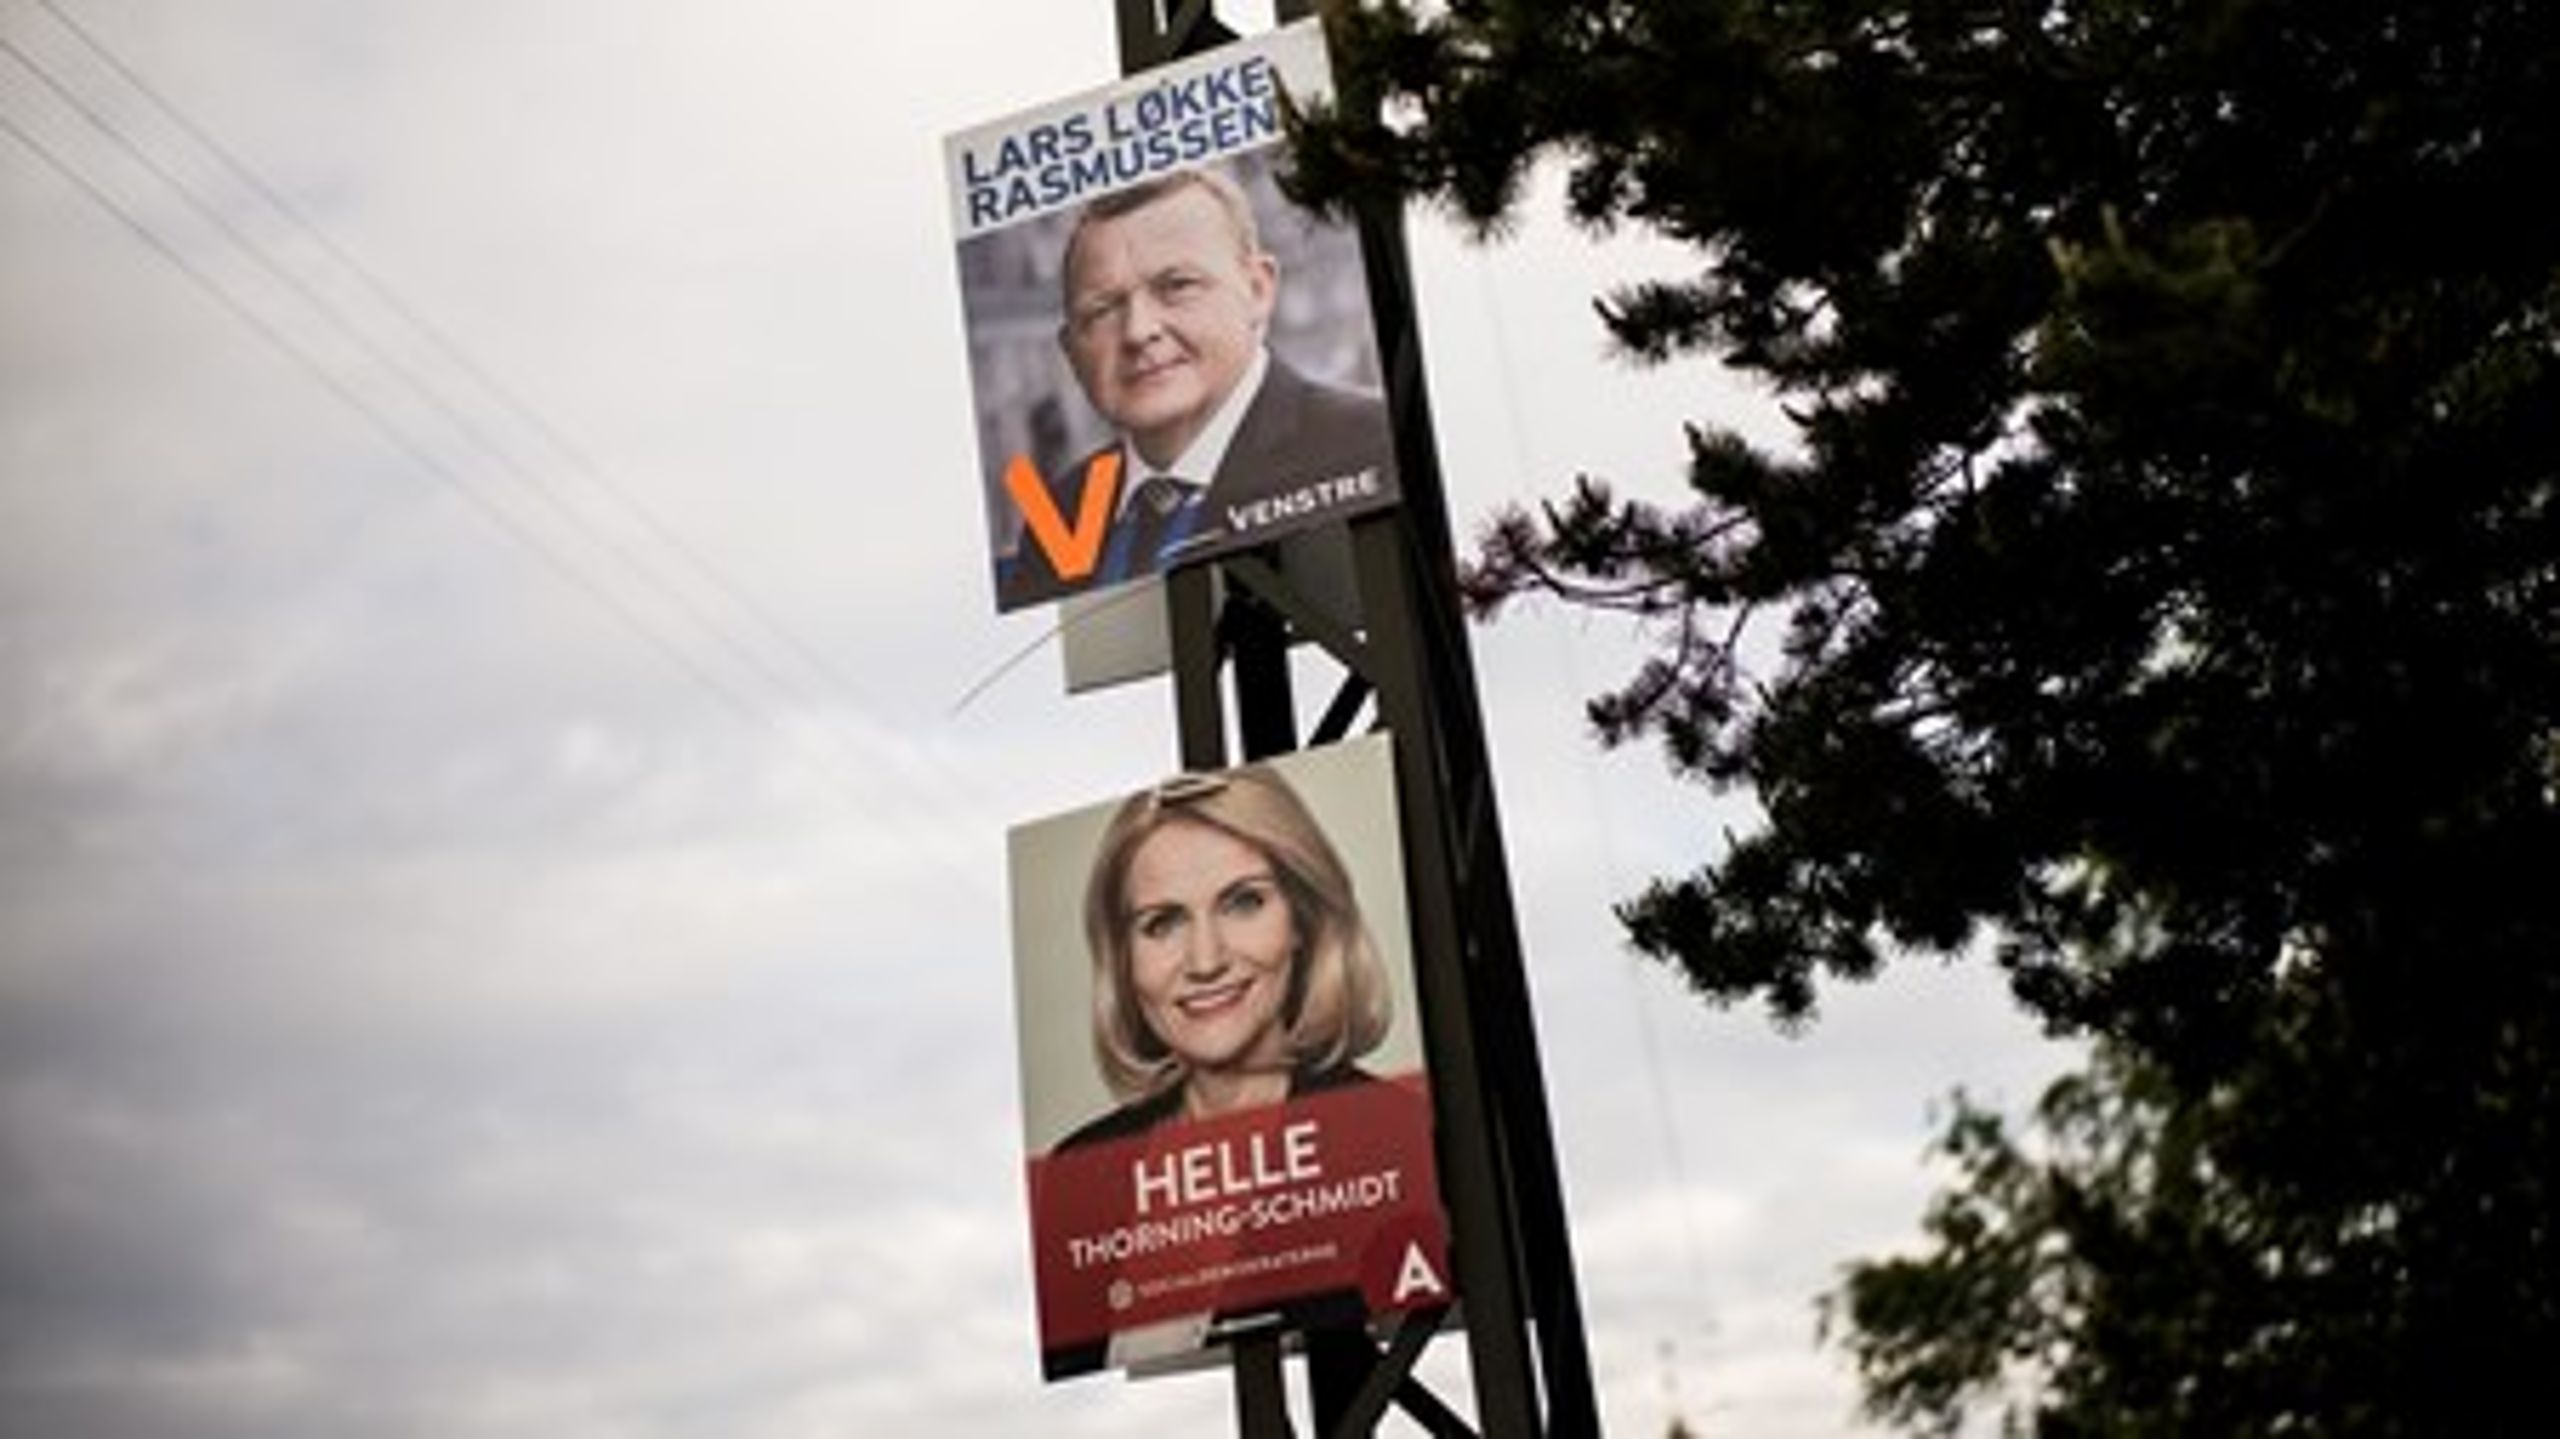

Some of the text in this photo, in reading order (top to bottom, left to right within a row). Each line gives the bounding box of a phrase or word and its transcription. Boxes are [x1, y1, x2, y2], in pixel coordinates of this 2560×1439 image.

[963, 56, 1270, 186] LARS LØKKE
[967, 103, 1277, 227] RASMUSSEN
[1005, 453, 1122, 581] V
[1228, 468, 1382, 531] VENSTRE
[1134, 1122, 1322, 1213] HELLE
[1069, 1171, 1399, 1268] THORNING-SCHMIDT
[1394, 1242, 1442, 1302] A
